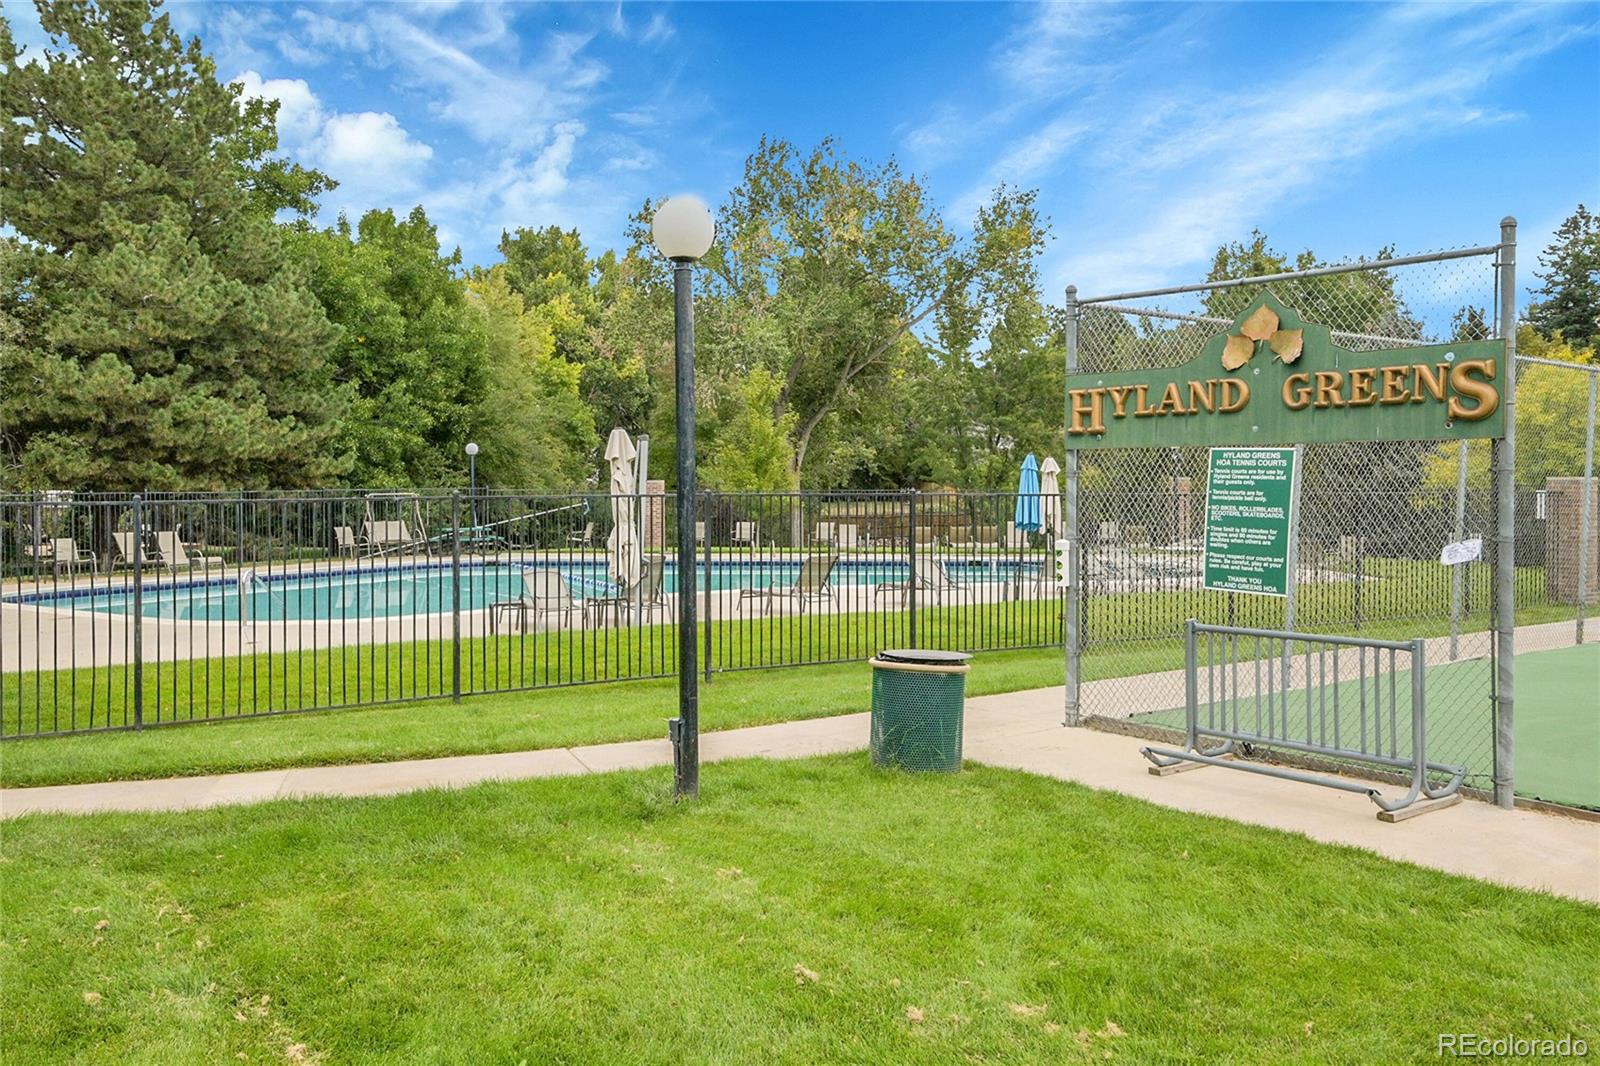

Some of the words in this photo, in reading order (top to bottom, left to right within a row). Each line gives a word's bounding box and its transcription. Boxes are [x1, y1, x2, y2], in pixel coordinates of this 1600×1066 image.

[1068, 376, 1251, 435] HYLAND
[1281, 358, 1499, 420] GREENS
[1238, 583, 1262, 591] GREENS
